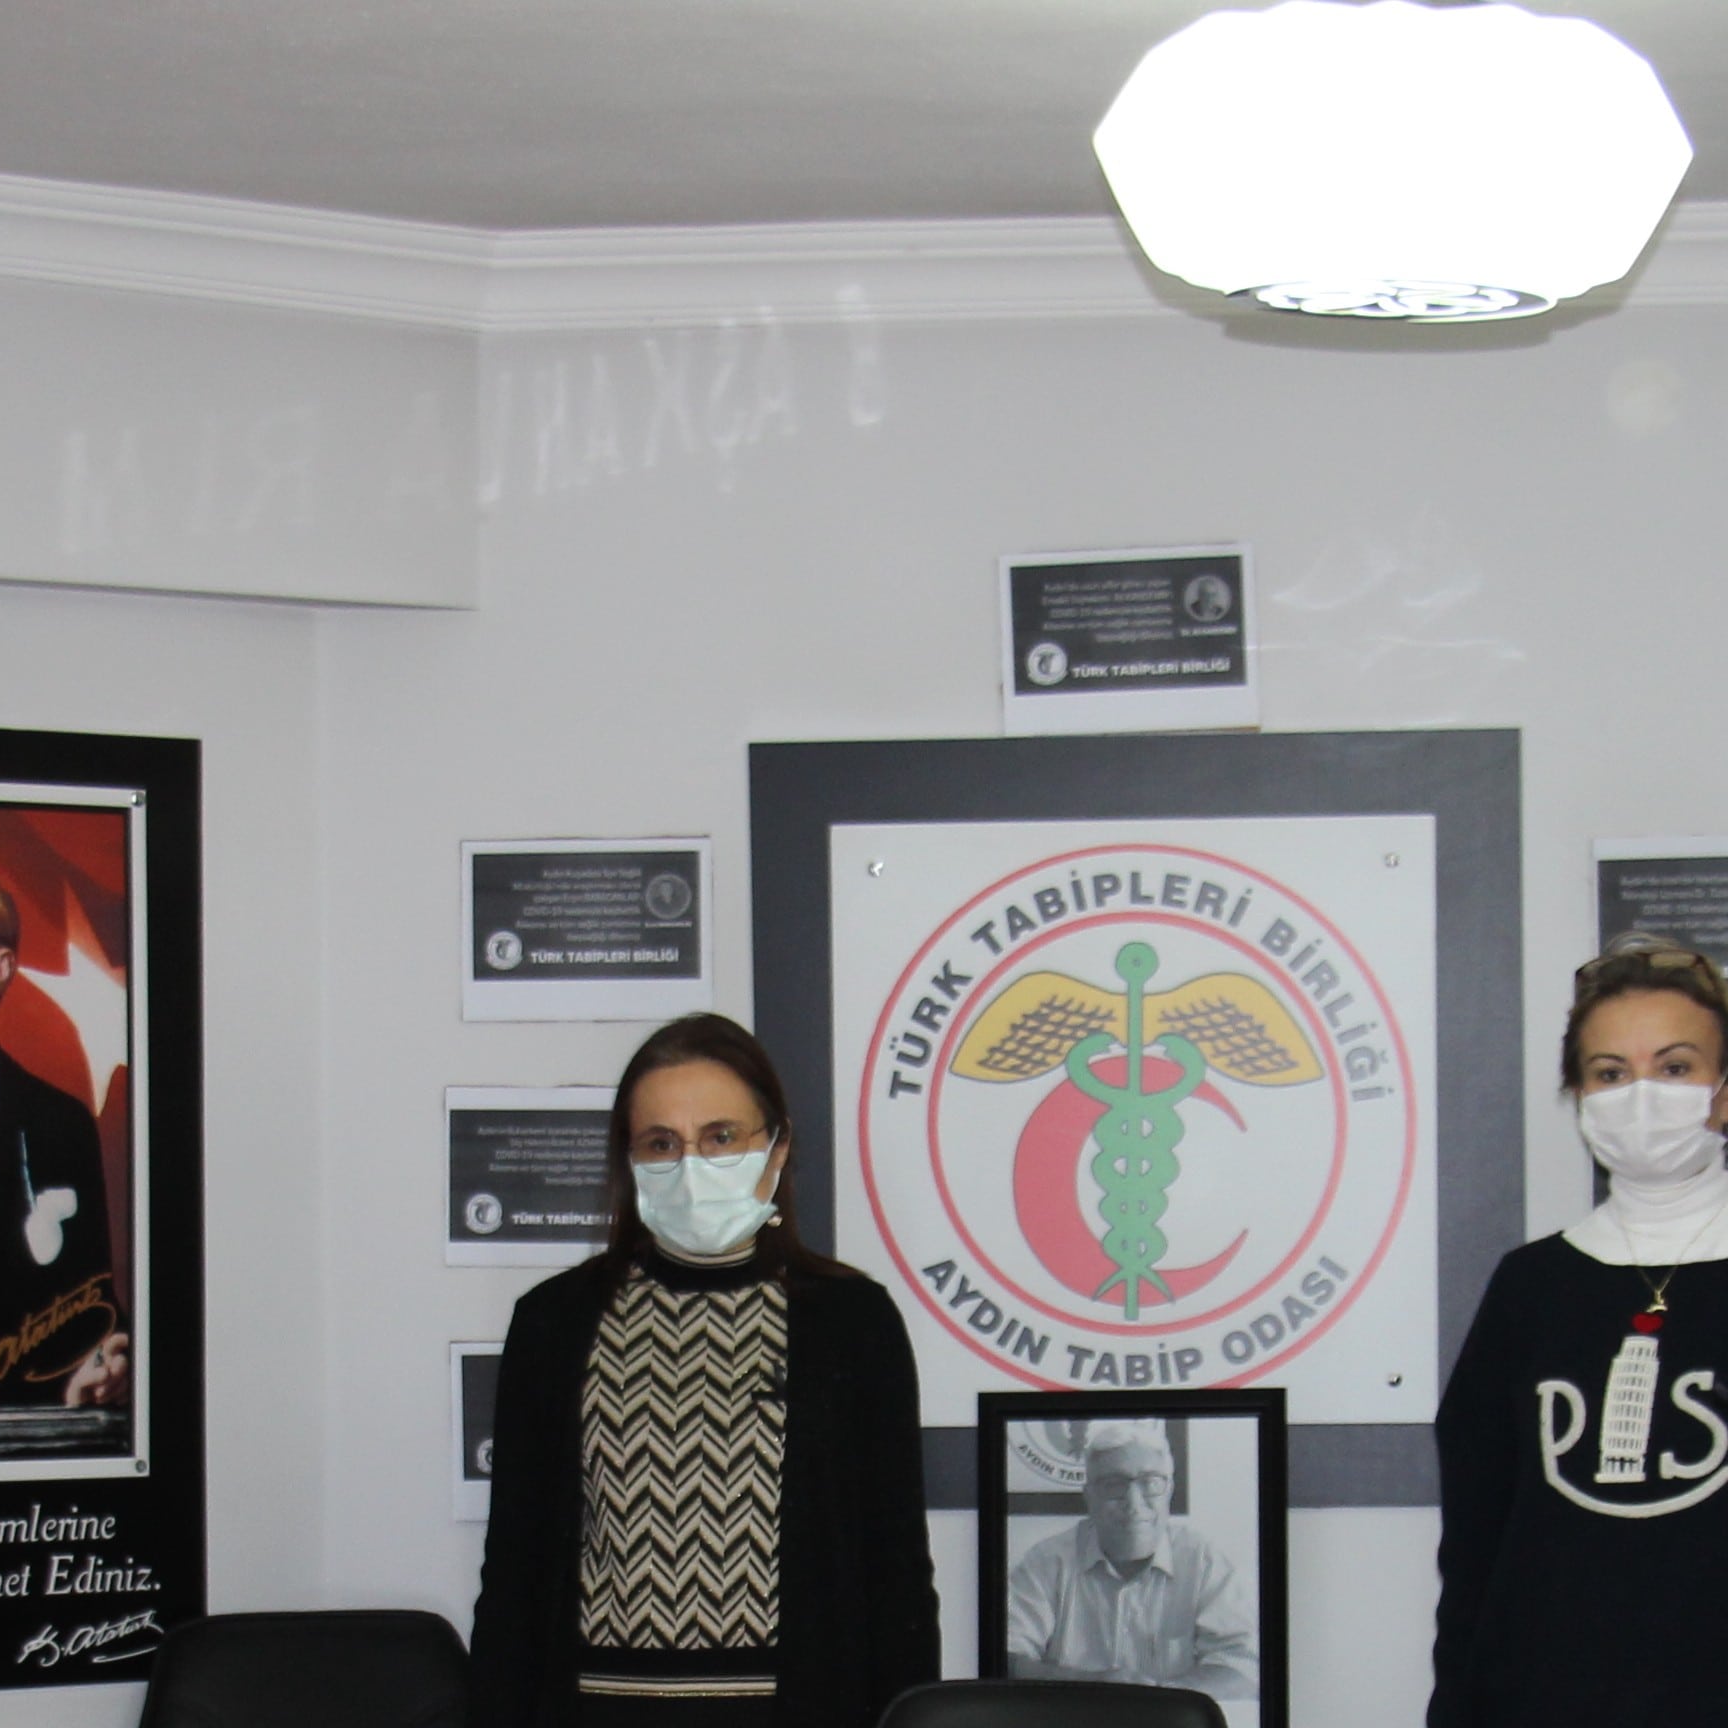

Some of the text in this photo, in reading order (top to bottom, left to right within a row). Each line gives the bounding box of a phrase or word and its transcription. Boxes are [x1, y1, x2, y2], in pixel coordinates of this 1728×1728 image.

[1072, 664, 1109, 679] TÜRK
[531, 949, 564, 964] TÜRK
[888, 869, 1396, 1104] TÜRK TABİPLERİ BİRLİĞİ
[512, 1211, 544, 1226] TÜRK
[922, 1255, 1349, 1389] AYDIN TABİP ODASI
[1018, 1444, 1056, 1475] AYDIN
[45, 1552, 161, 1597] Ediniz.
